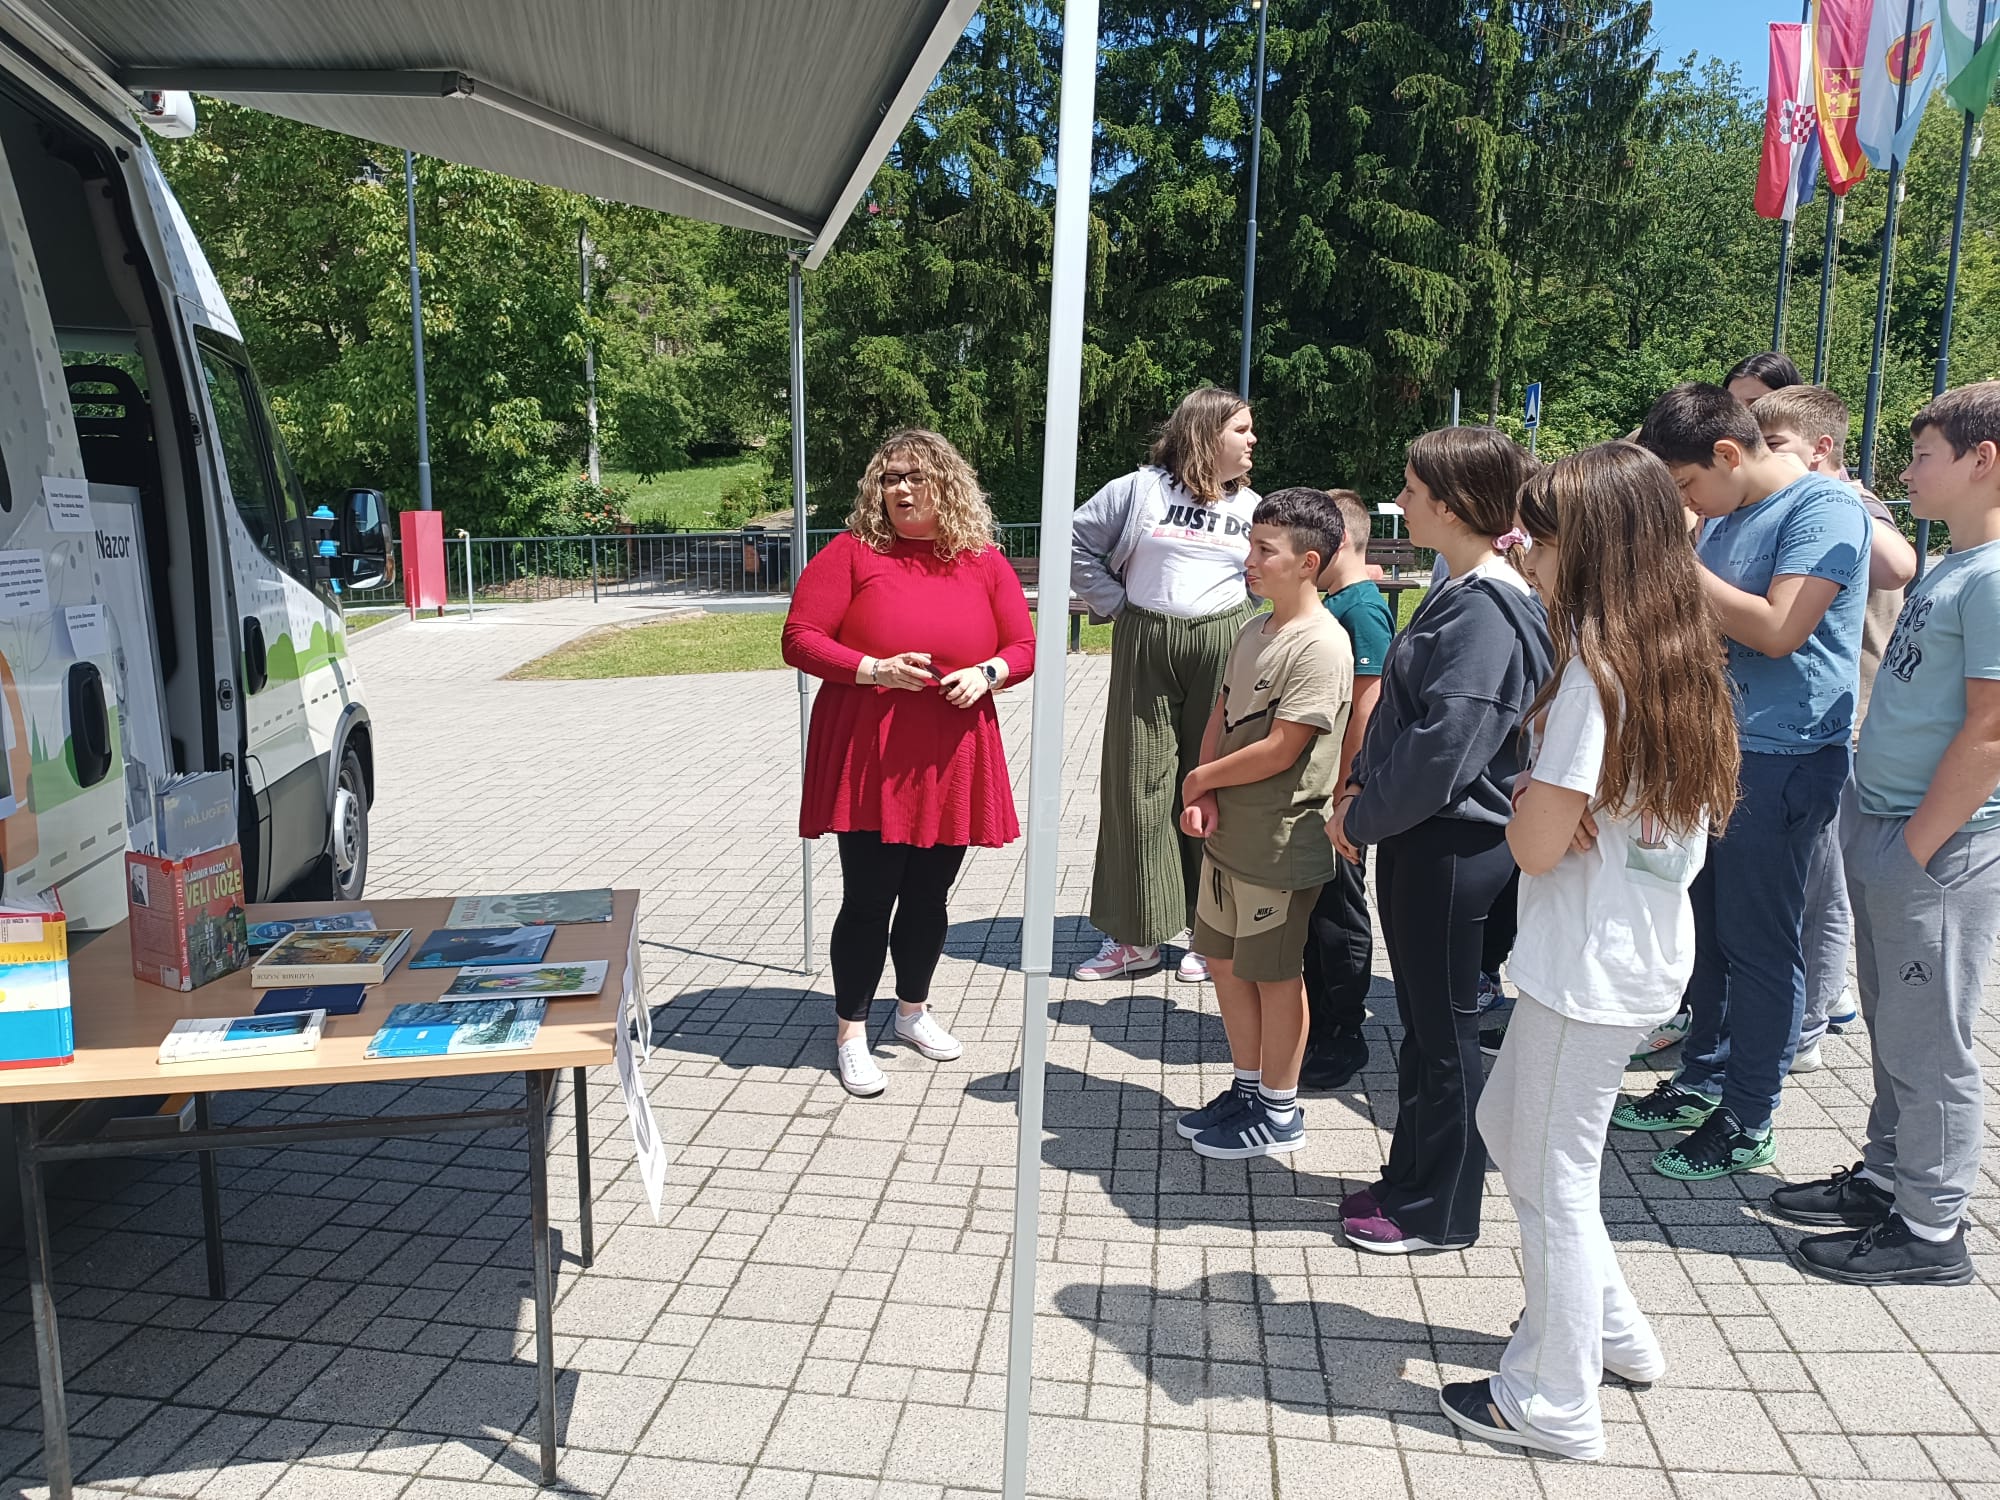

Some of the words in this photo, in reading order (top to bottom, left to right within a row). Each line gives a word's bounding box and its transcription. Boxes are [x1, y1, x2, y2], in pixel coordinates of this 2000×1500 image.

[1159, 505, 1221, 532] JUST
[95, 529, 130, 559] Nazor
[185, 880, 211, 908] VELI
[1257, 906, 1274, 916] NIKE
